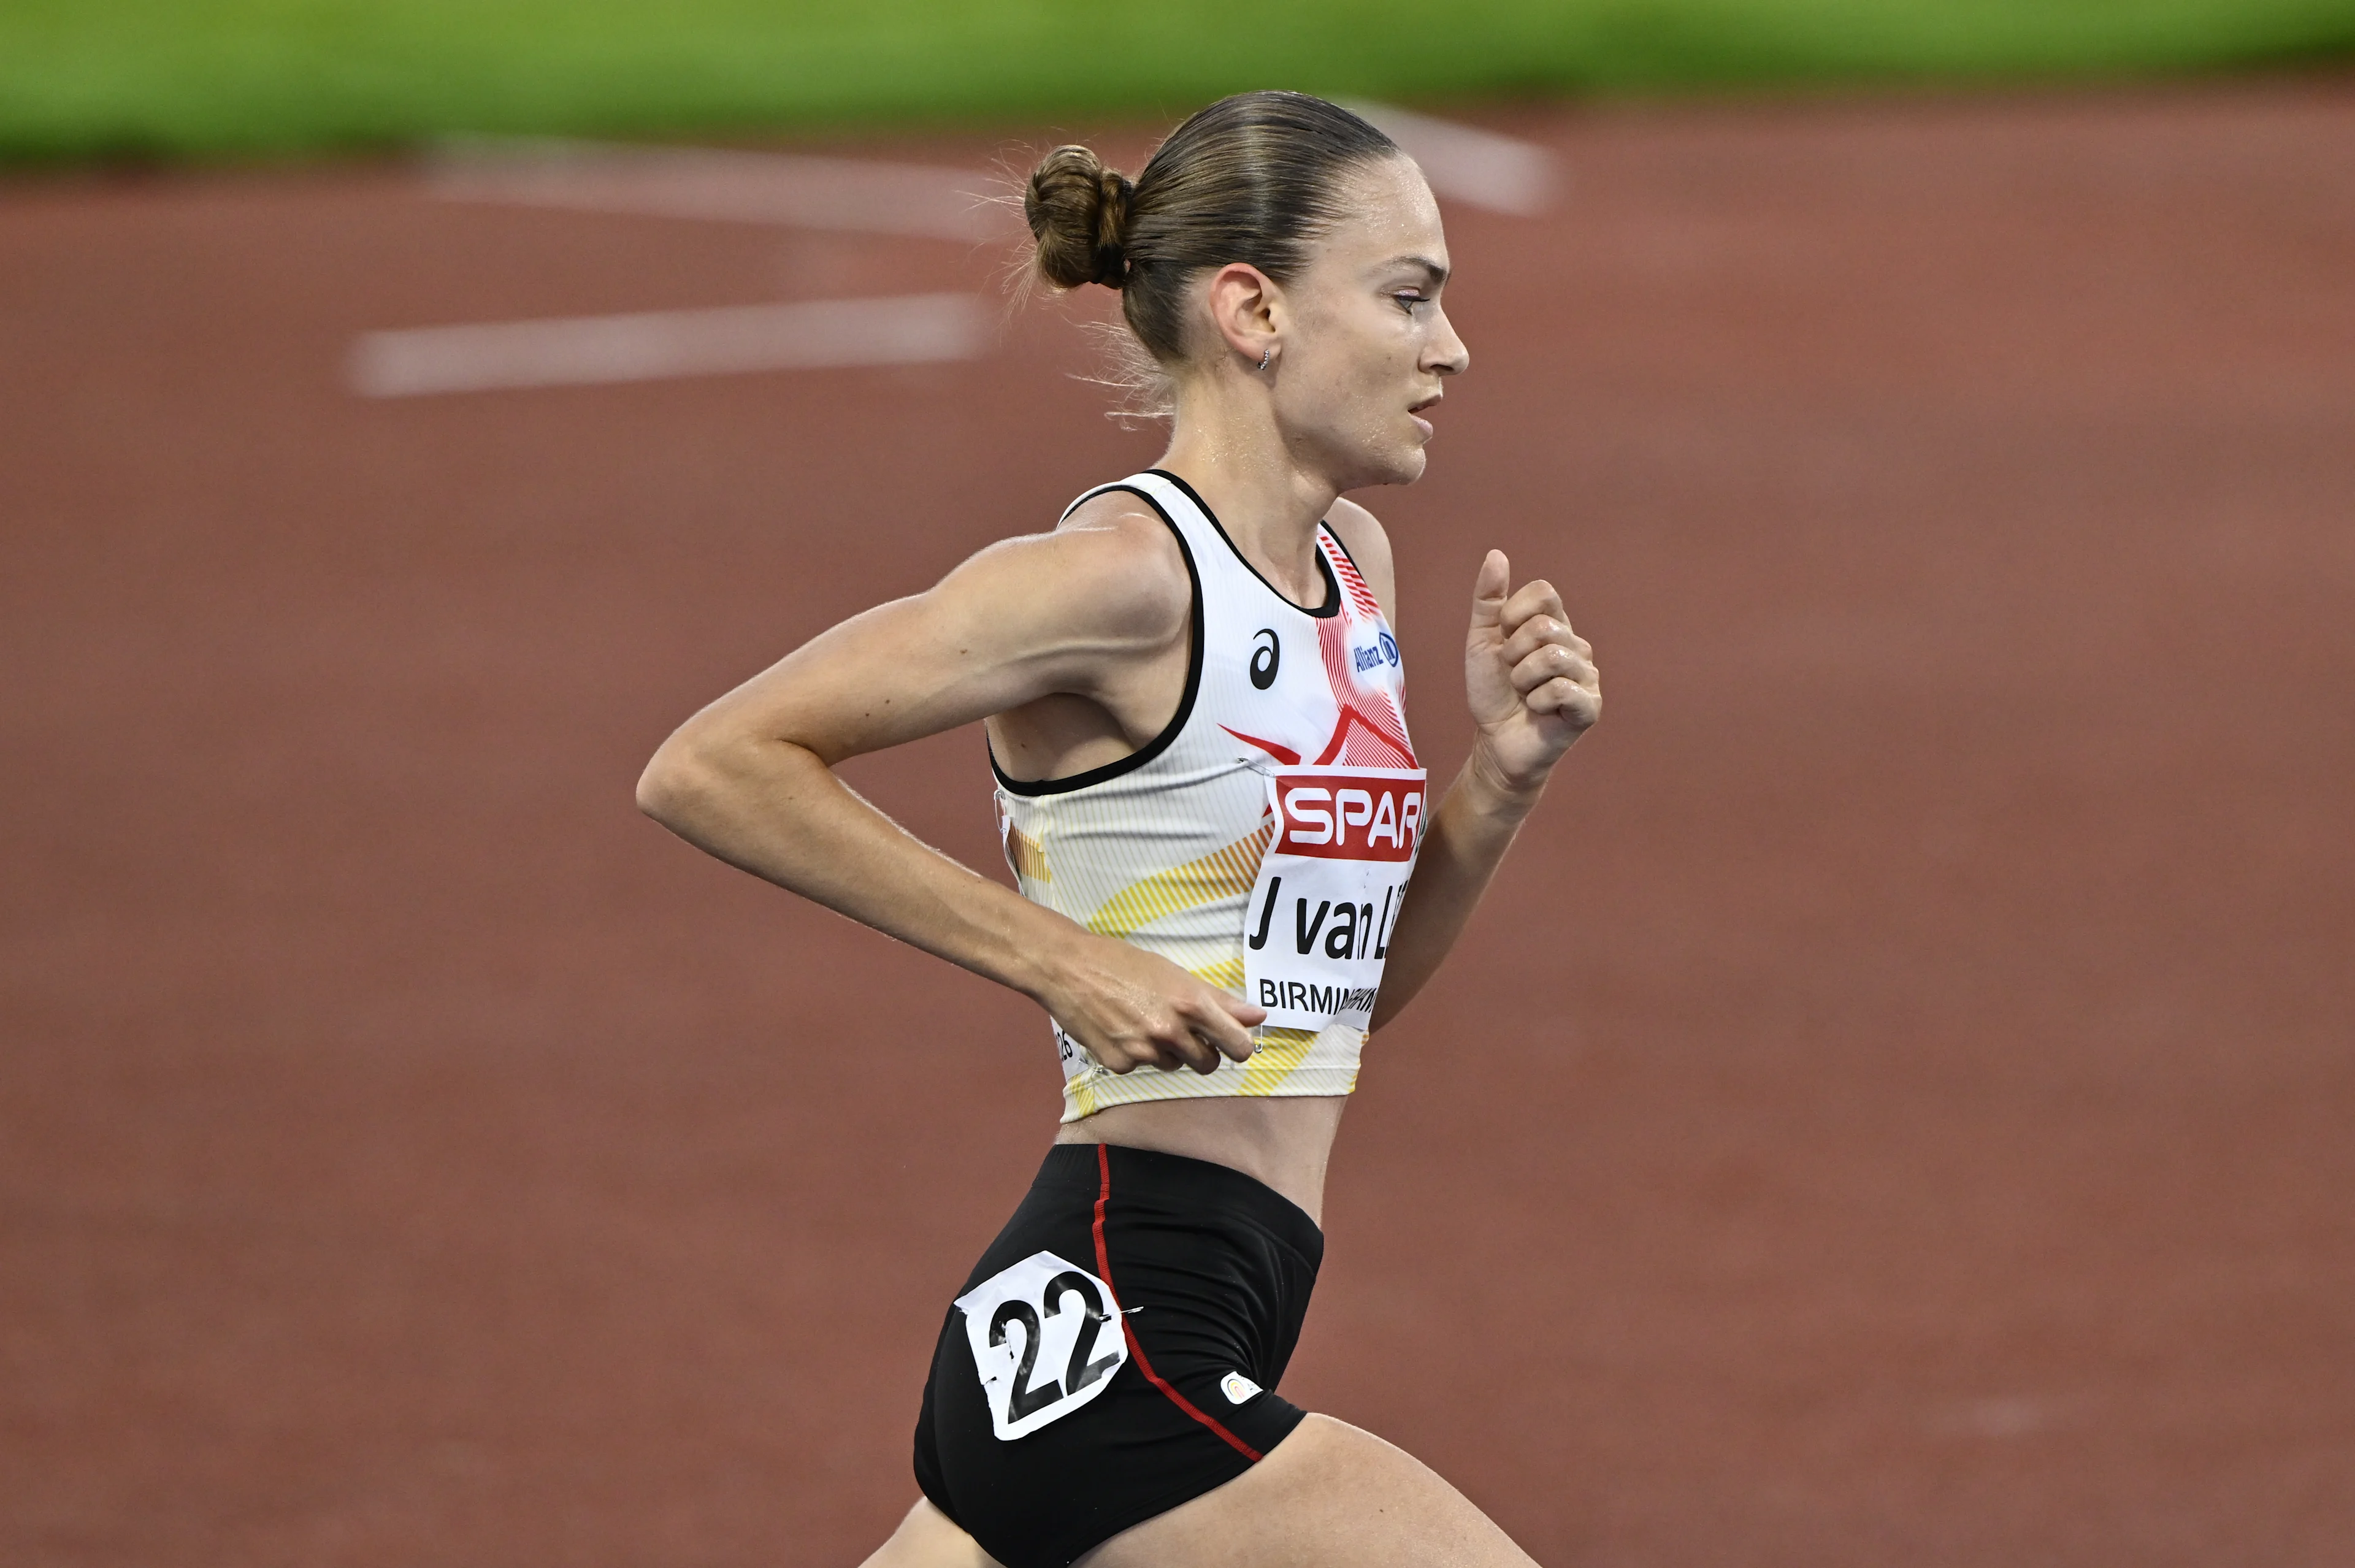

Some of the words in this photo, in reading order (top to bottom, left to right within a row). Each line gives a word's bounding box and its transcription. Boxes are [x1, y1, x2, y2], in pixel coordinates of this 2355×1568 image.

[1354, 646, 1384, 673] Allianz
[1285, 787, 1422, 849] SPAR
[1249, 876, 1282, 950] J
[1296, 897, 1373, 960] van
[988, 1270, 1121, 1425] 22
